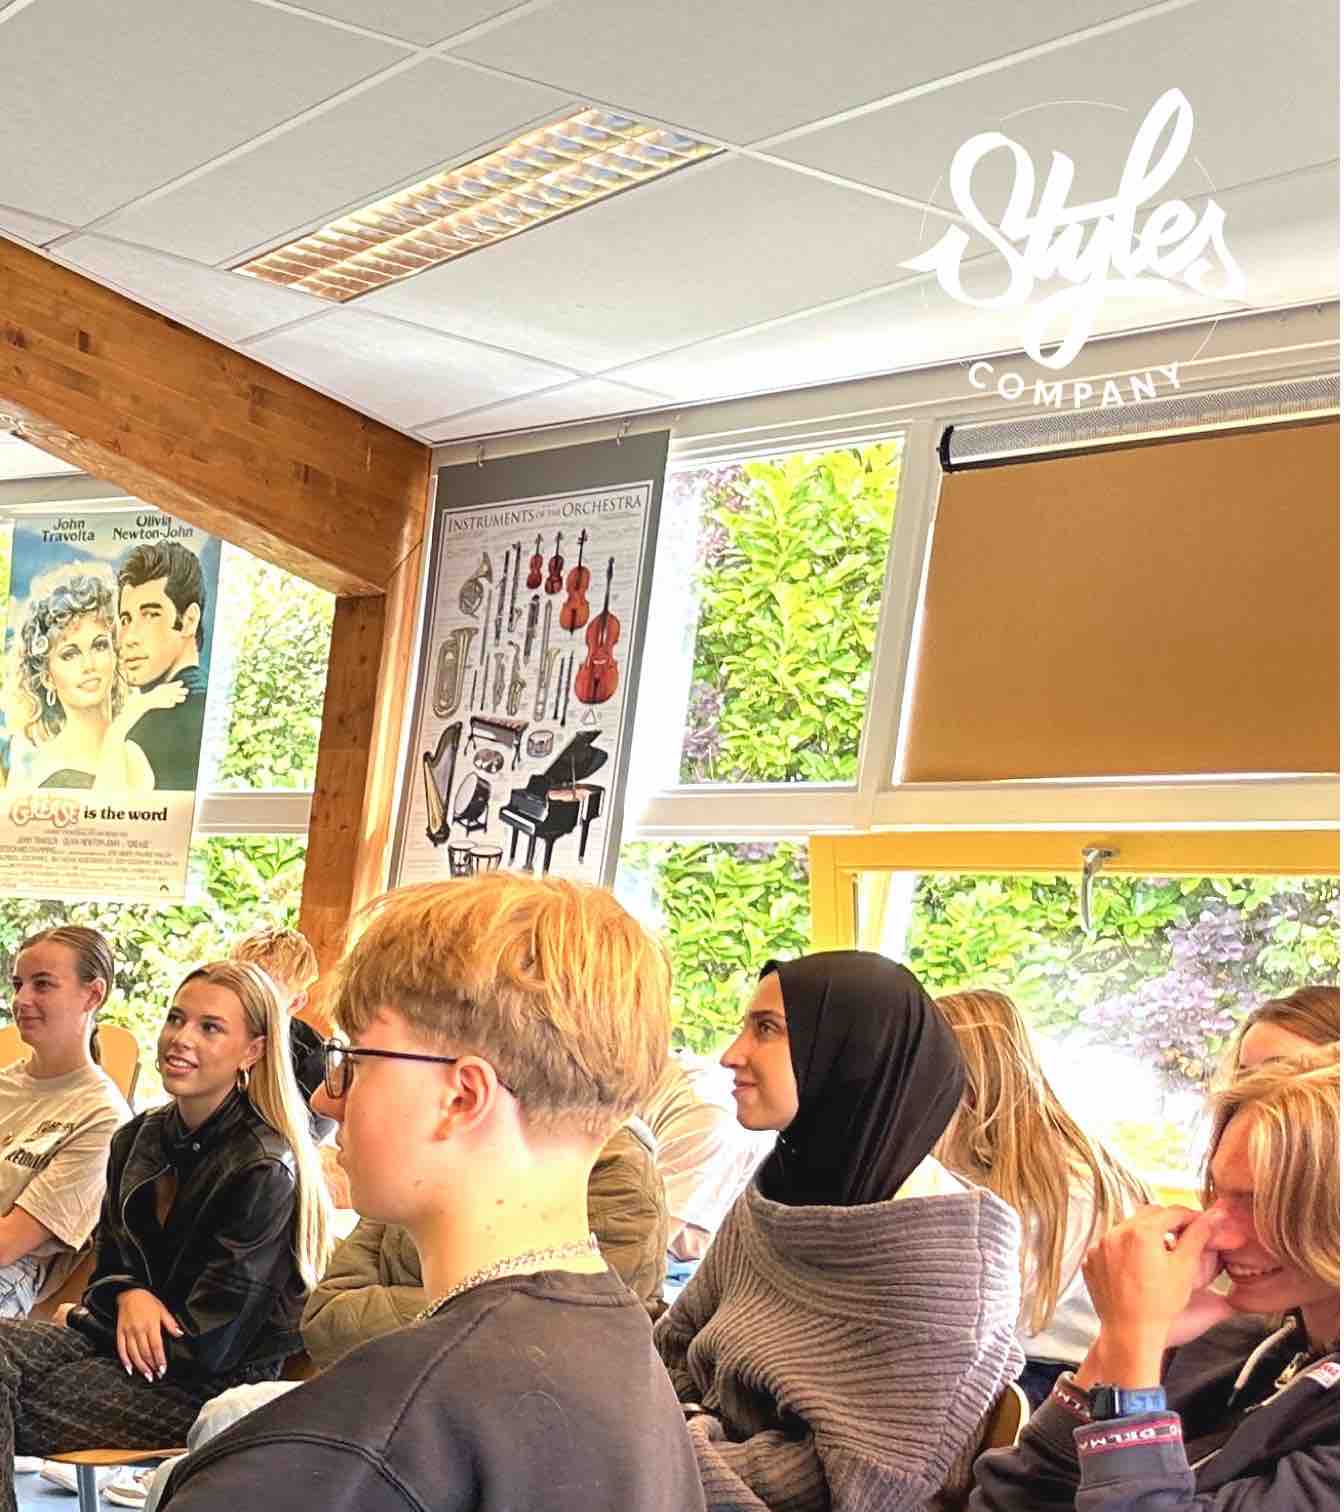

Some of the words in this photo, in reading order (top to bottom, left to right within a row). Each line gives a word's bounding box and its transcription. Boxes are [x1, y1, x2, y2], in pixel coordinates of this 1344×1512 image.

[448, 509, 535, 533] INSTRUMENTS
[562, 495, 642, 517] ORCHESTRA
[53, 517, 85, 531] John
[41, 528, 96, 543] Travolta
[113, 526, 194, 541] Newton-John
[84, 805, 97, 819] is
[101, 805, 125, 820] the
[128, 807, 168, 821] word
